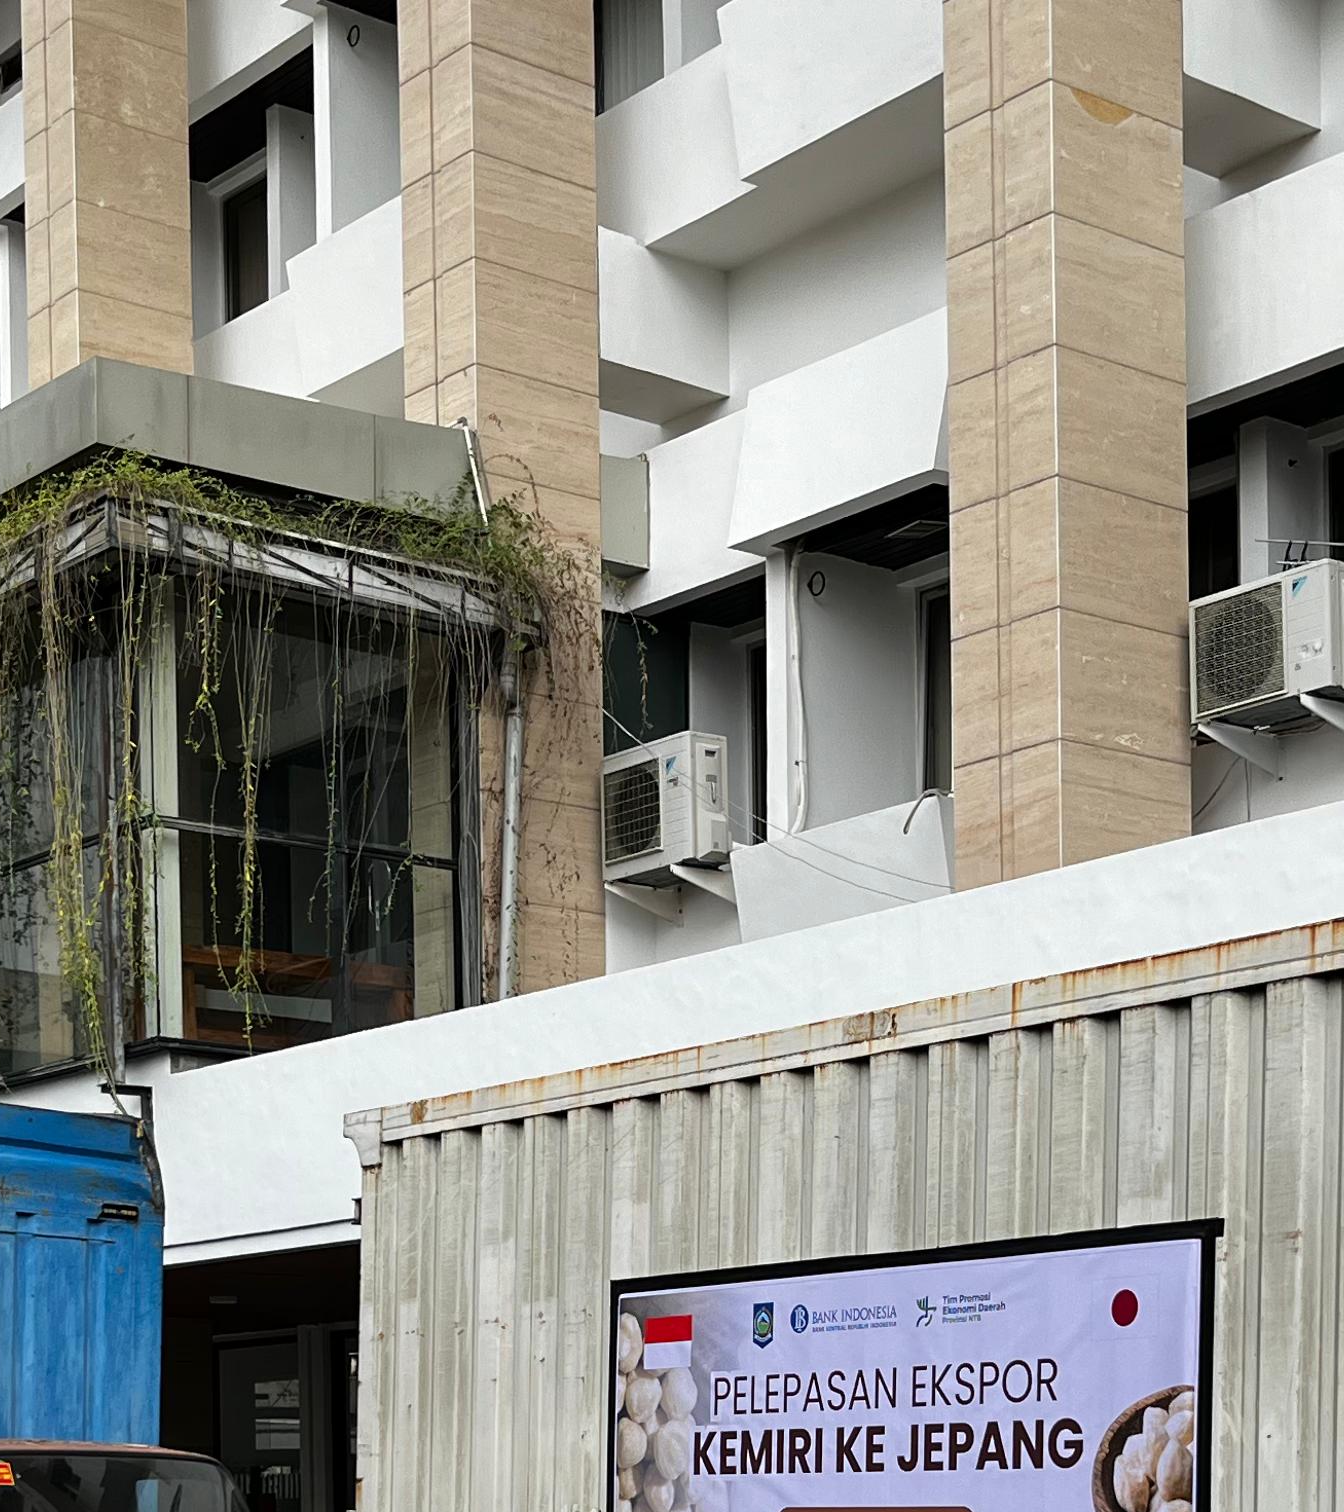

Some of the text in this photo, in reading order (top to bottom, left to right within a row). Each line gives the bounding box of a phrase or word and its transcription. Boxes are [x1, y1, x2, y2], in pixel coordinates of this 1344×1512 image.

[812, 1305, 897, 1325] BANK INDONESIA
[978, 1301, 1006, 1312] Daerah
[713, 1358, 1058, 1416] PELEPASAN EKSPOR
[693, 1417, 1084, 1475] KEMIRI KE JEPANG
